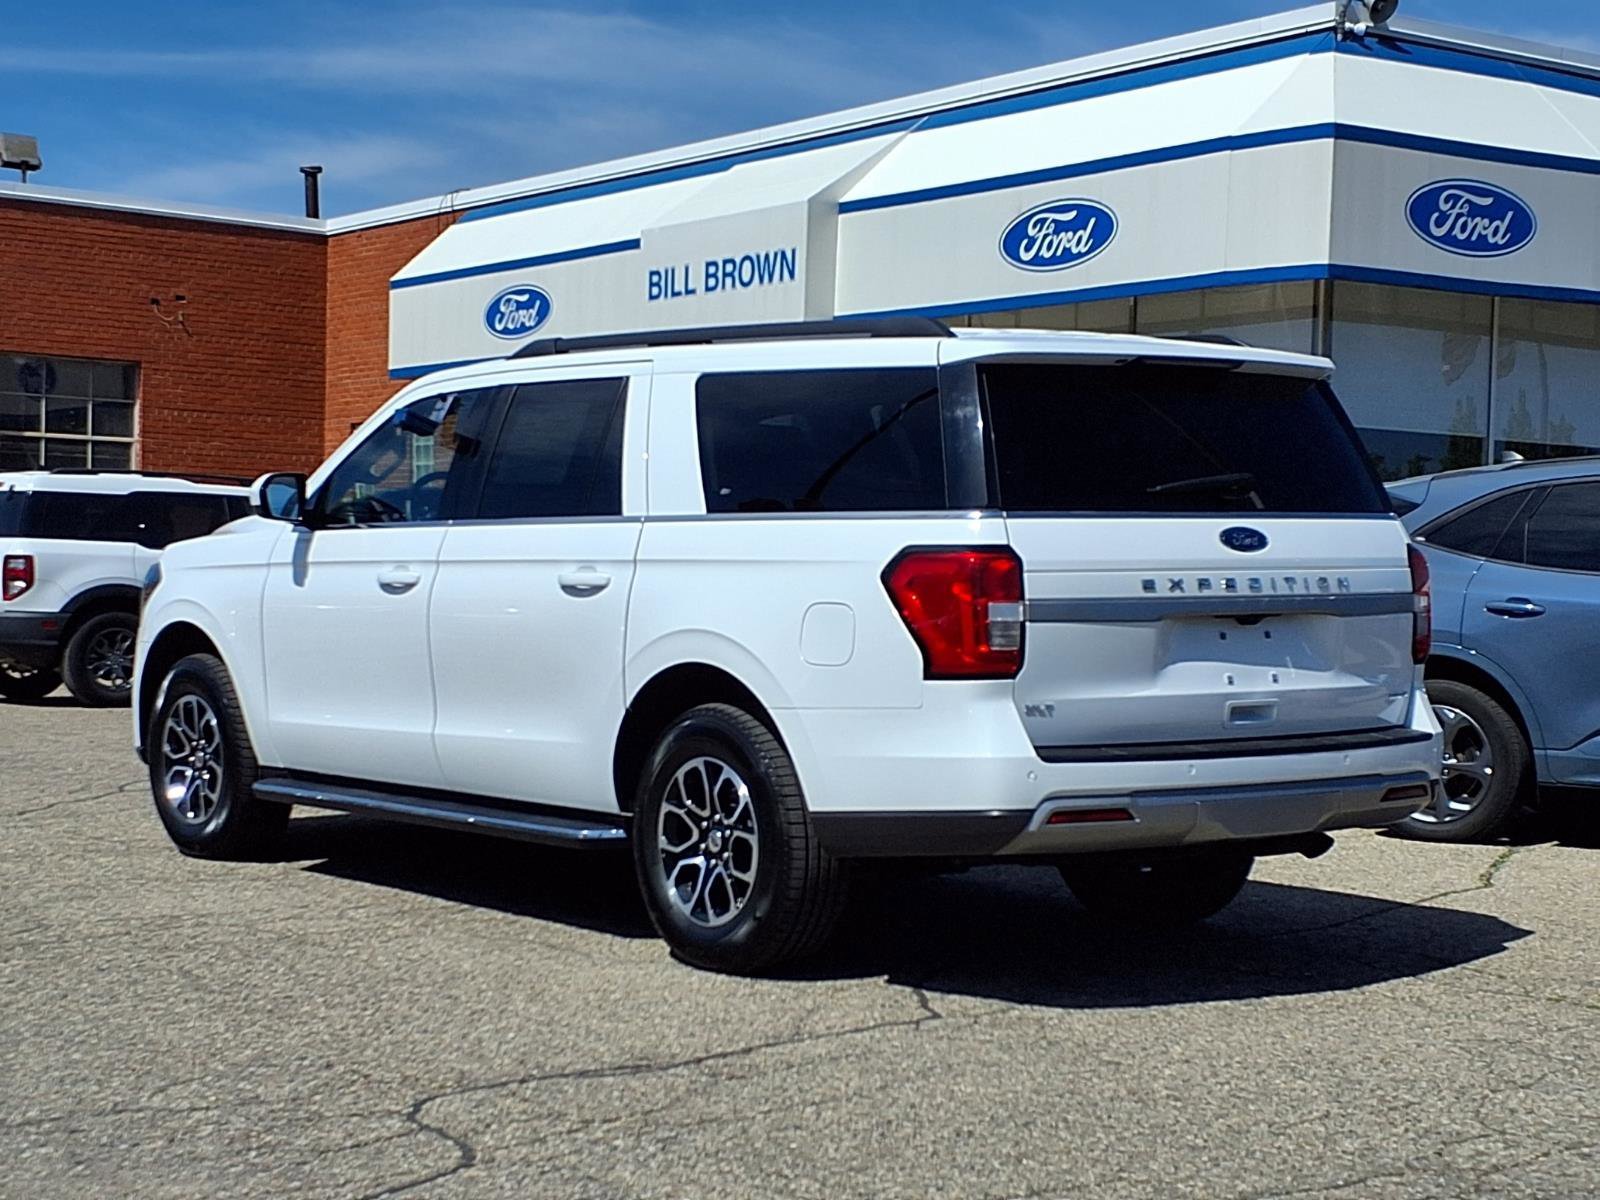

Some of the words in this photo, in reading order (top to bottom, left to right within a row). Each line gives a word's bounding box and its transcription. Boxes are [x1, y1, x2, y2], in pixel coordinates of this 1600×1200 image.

[1019, 210, 1096, 261] Ford
[1429, 189, 1513, 245] Ford
[649, 264, 696, 301] BILL
[704, 247, 797, 293] BROWN
[494, 293, 539, 331] Ford
[1141, 576, 1350, 594] EXPEDITION
